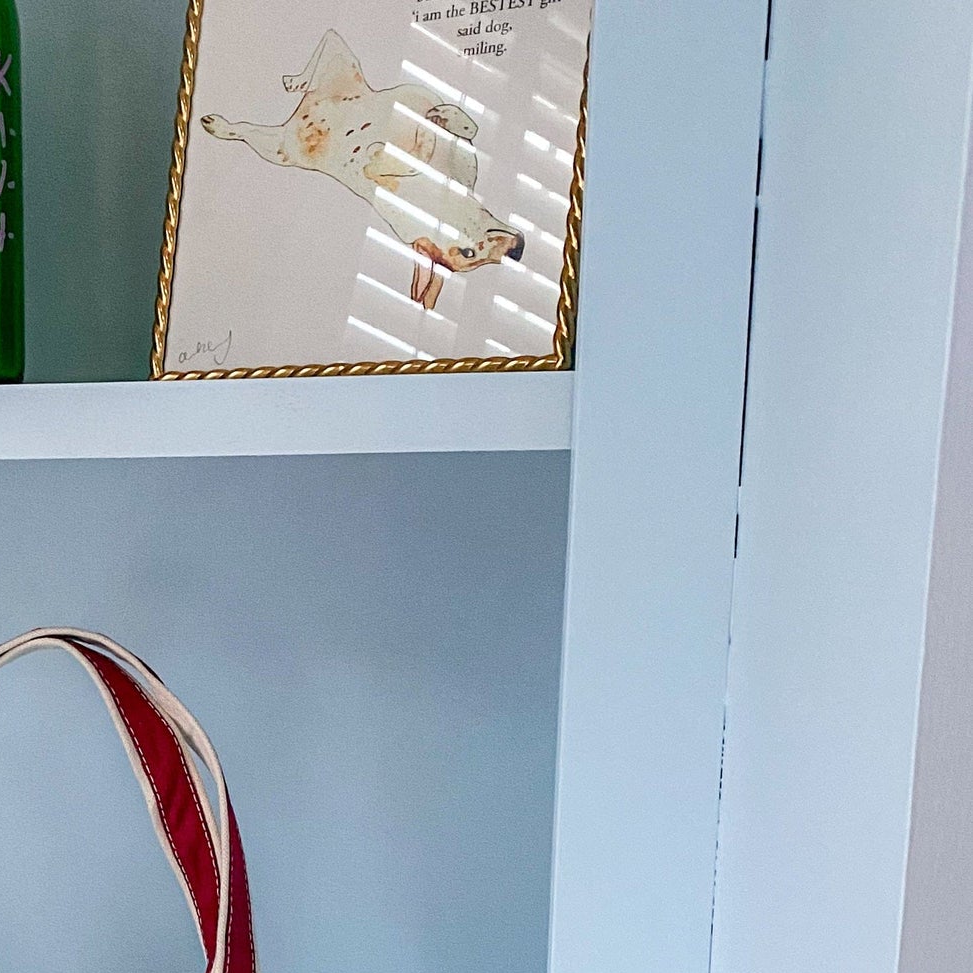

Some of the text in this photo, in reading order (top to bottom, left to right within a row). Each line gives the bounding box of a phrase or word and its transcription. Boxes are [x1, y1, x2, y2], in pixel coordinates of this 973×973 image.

[422, 11, 442, 22] am
[446, 4, 466, 19] the
[456, 19, 513, 38] said dog,
[459, 41, 508, 57] miling.
